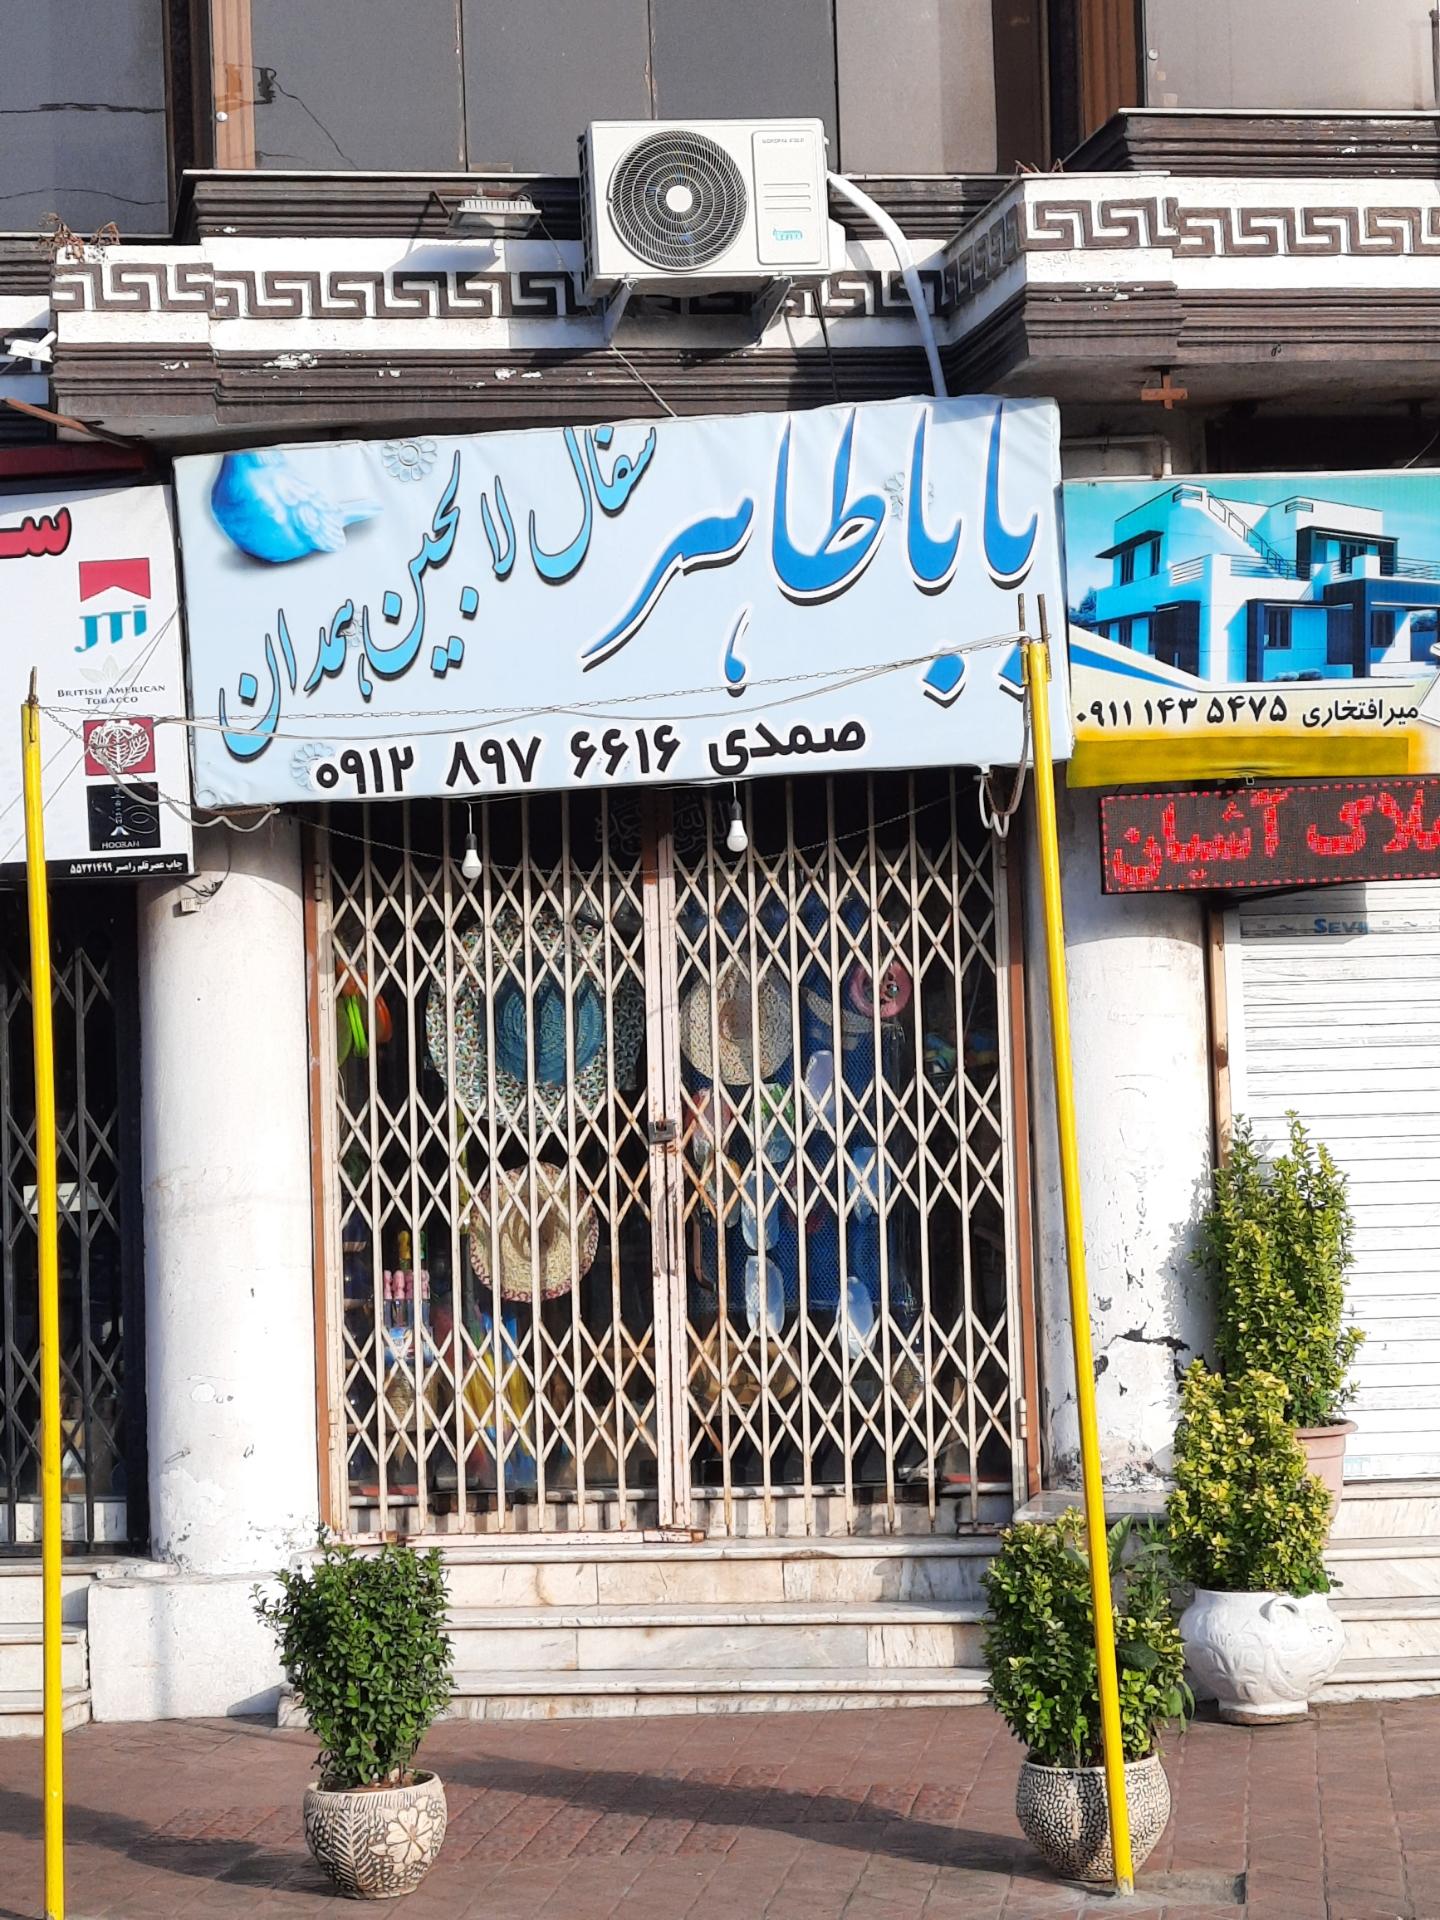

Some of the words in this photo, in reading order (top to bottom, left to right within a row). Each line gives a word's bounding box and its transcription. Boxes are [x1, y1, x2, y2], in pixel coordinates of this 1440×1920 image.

[529, 425, 657, 587] سفال
[219, 598, 374, 764] همدان
[1076, 699, 1132, 727] ۰۹۱۱
[1144, 697, 1198, 726] ۱۴۳
[1206, 694, 1288, 724] ۵۴۷۵
[1302, 698, 1419, 728] میرافتخاری
[315, 744, 415, 795] ۰۹۱۲
[445, 736, 542, 789] ۸۹۷
[570, 724, 681, 779] ۶۶۱۶
[708, 720, 866, 777] صمدی
[1111, 788, 1289, 885] آشیان
